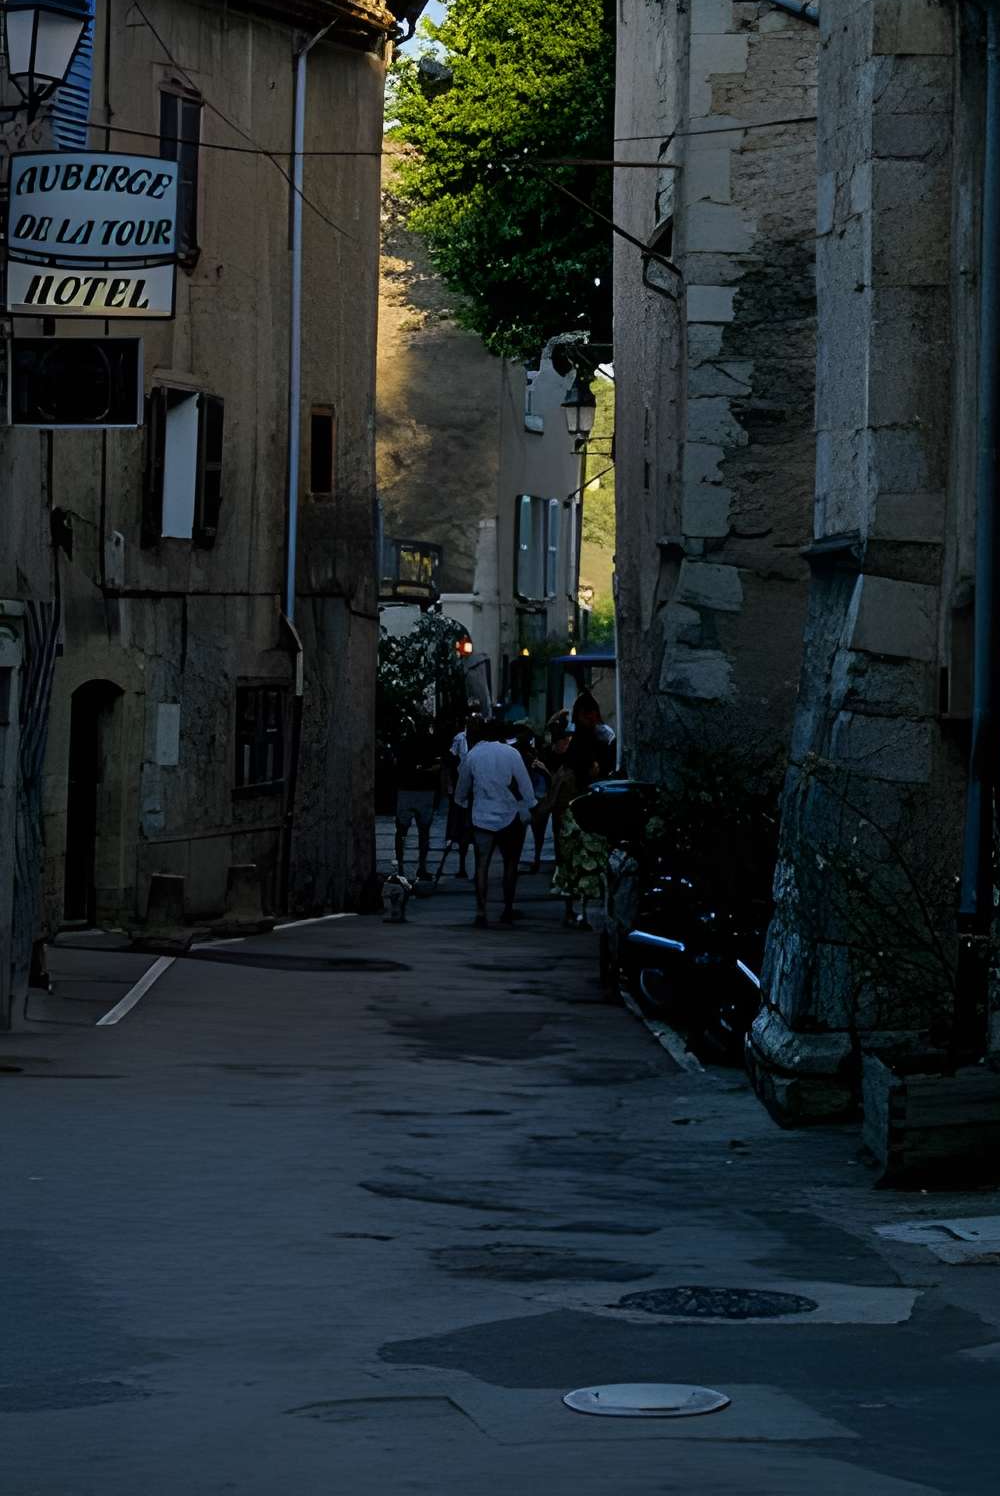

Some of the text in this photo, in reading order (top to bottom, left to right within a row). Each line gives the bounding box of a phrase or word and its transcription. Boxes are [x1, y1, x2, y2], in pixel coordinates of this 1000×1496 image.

[16, 164, 173, 199] AUBERGE
[14, 214, 172, 246] DE LA TOUR
[24, 275, 149, 309] HOTEL
